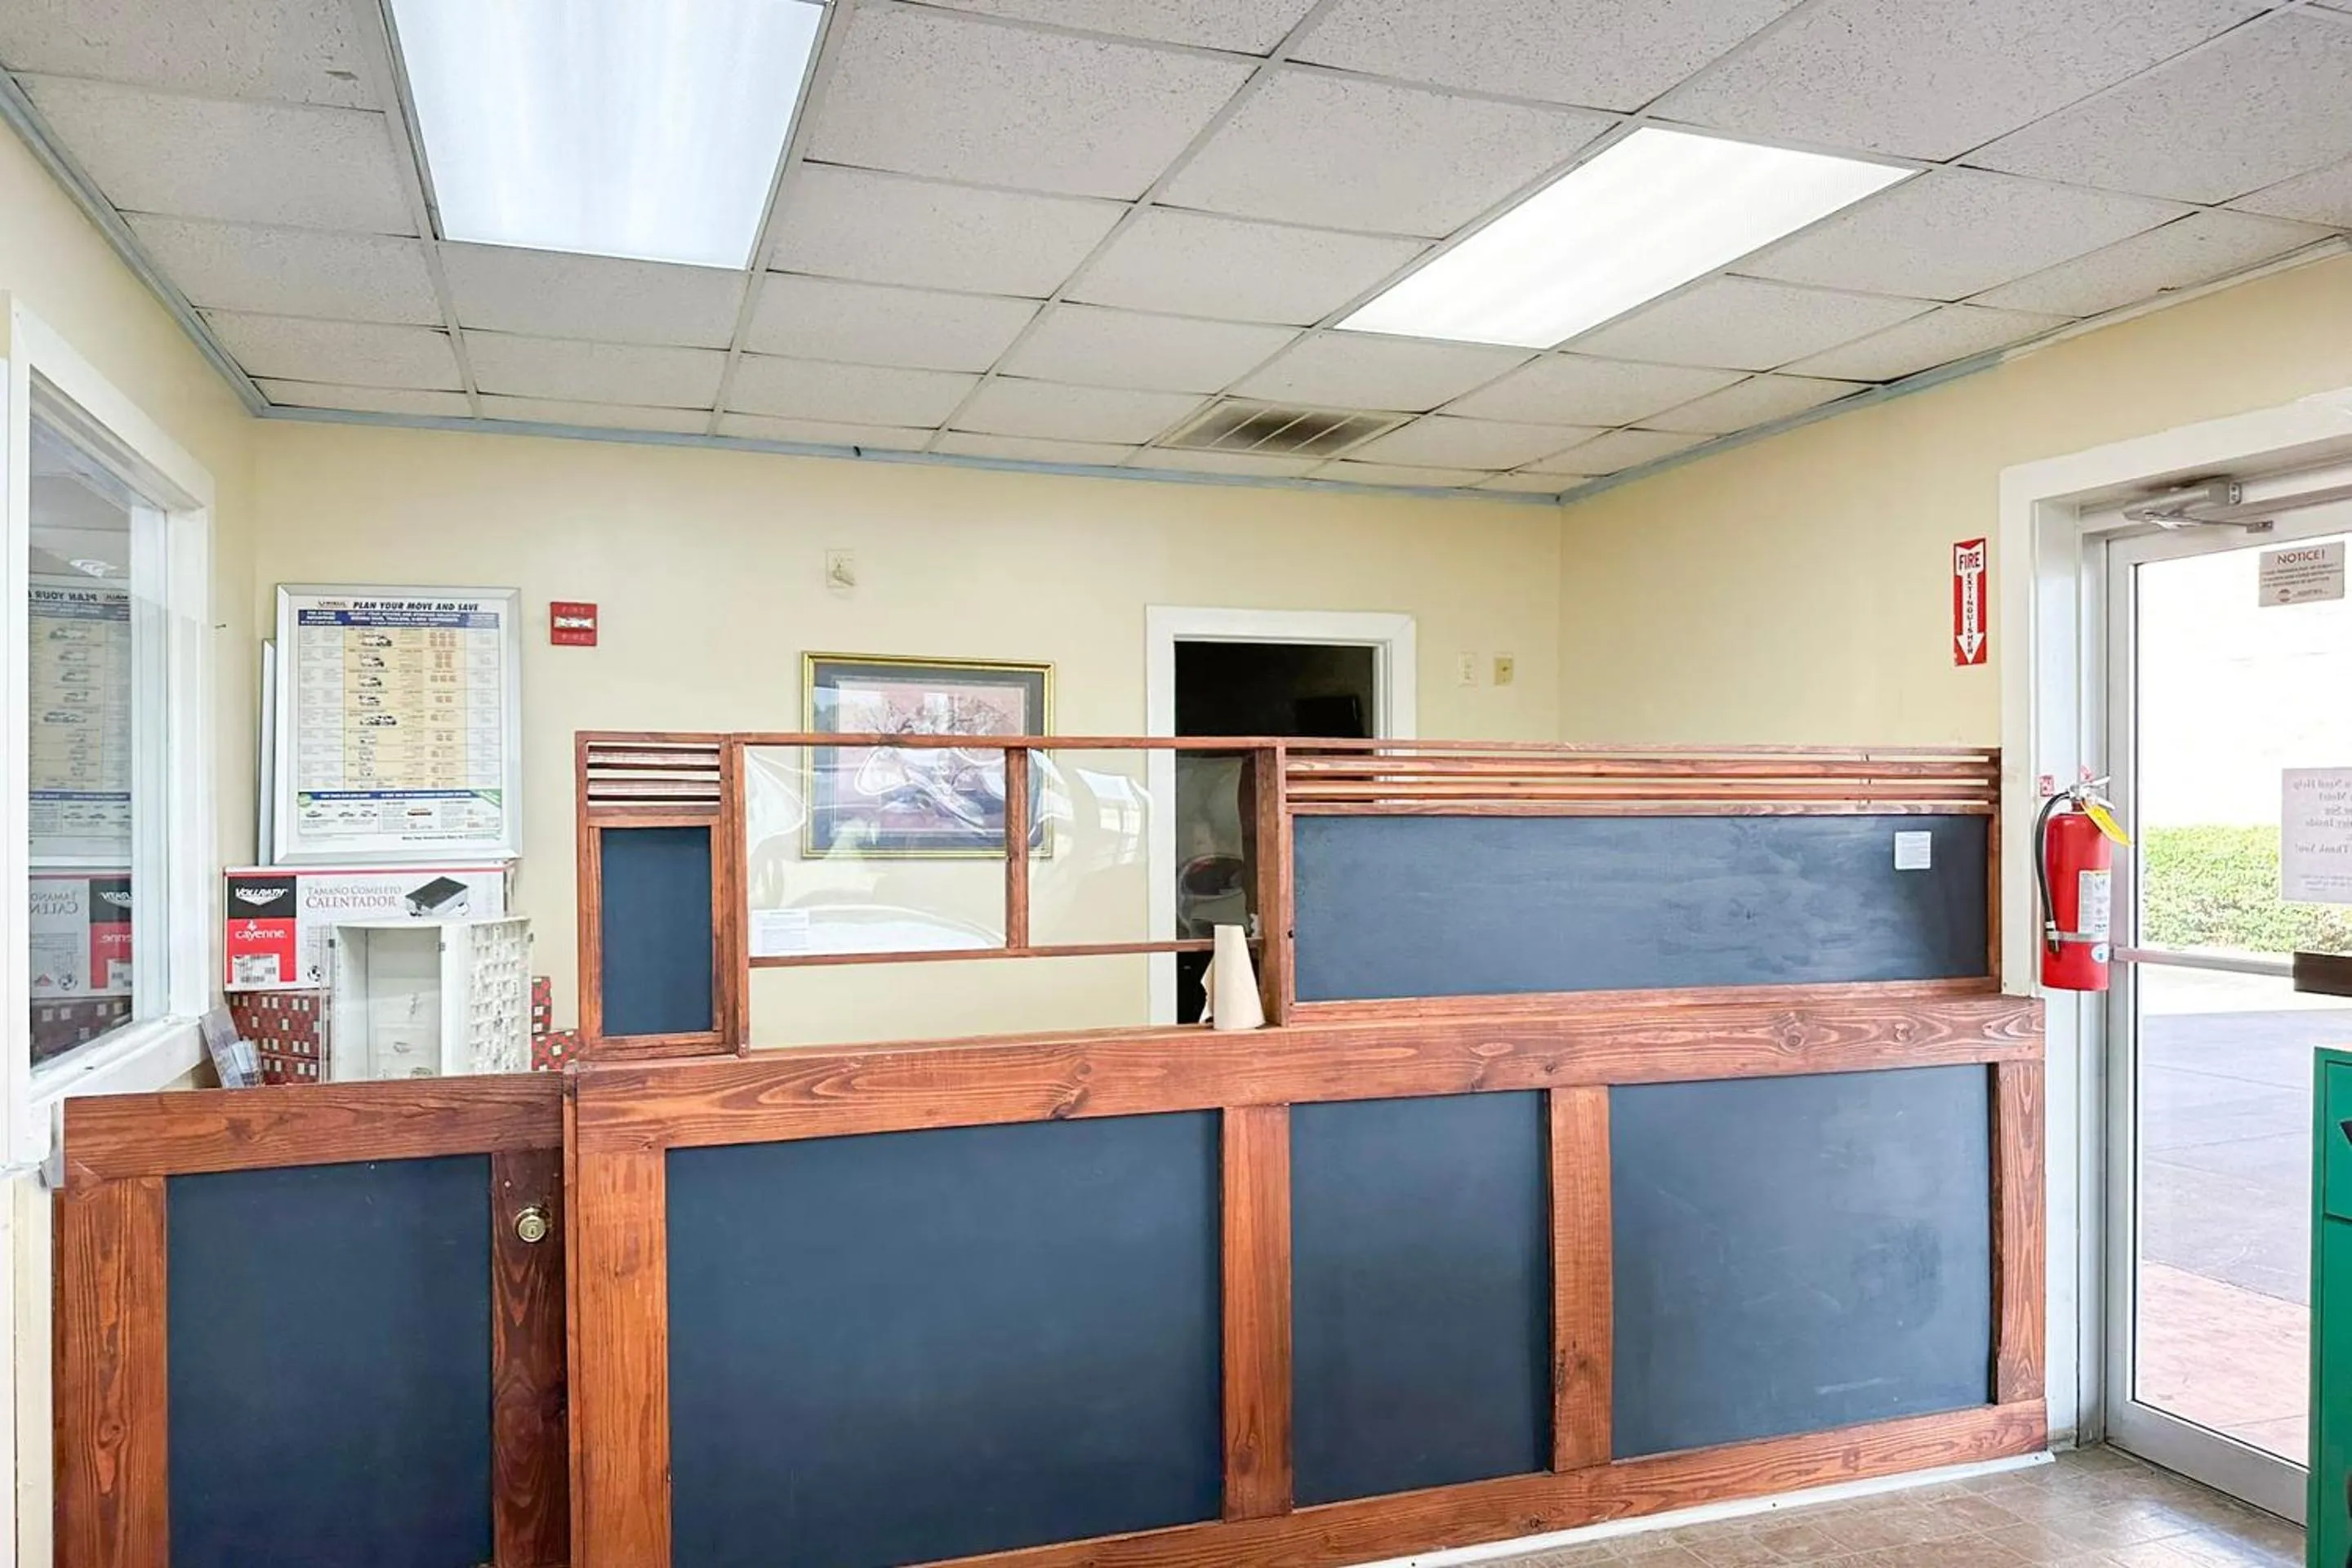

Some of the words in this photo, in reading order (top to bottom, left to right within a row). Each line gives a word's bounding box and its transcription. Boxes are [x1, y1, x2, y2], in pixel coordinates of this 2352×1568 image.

[1958, 551, 1980, 571] FIRE
[2277, 548, 2325, 564] NOTICE!
[407, 602, 433, 611] MOVE
[436, 603, 456, 611] AND
[457, 603, 479, 611] SAVE
[305, 895, 397, 908] CALENTADOR
